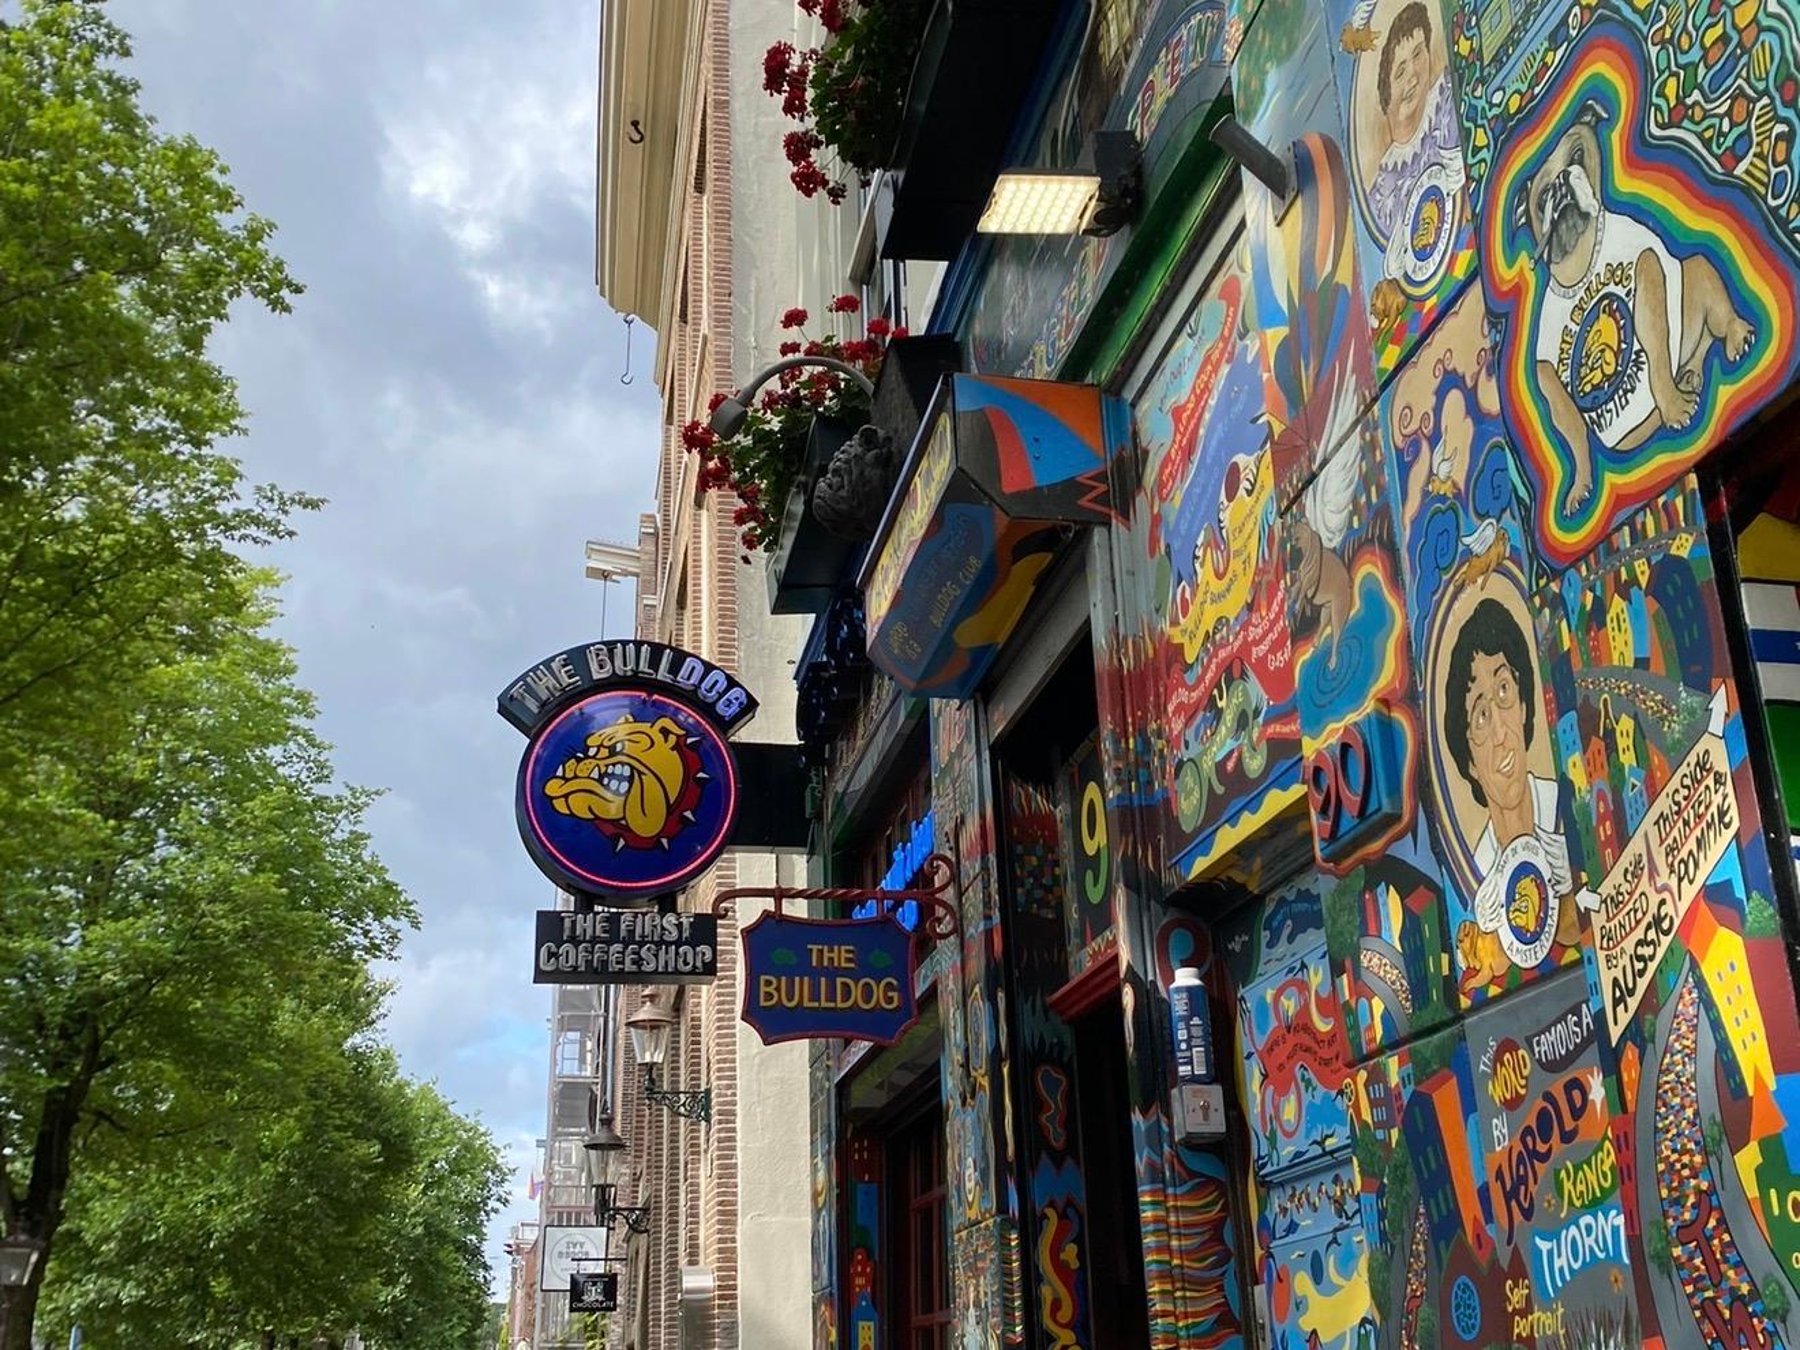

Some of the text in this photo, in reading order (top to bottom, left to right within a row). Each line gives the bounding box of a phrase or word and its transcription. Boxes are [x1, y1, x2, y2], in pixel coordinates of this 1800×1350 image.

[1556, 262, 1634, 379] THE BULLDOG
[508, 642, 748, 721] THE BULLDOG
[1308, 725, 1367, 841] 90
[1081, 780, 1109, 905] 9
[1653, 792, 1682, 847] This
[1664, 780, 1713, 868] PAINTED
[1676, 793, 1733, 901] POMMIE
[560, 912, 695, 942] THE FIRST
[1600, 890, 1650, 950] PAINTED
[539, 941, 714, 974] COFFEESHOP
[806, 944, 856, 970] THE
[1611, 897, 1675, 1027] AUSSIE
[759, 975, 900, 1011] BULLDOG
[1488, 1047, 1532, 1108] WORLD
[1532, 1011, 1582, 1065] FAMOUS
[1492, 1112, 1508, 1152] BY
[571, 1300, 615, 1309] CHOCOLATE
[1505, 1278, 1529, 1312] Self
[1513, 1303, 1566, 1348] portrait
